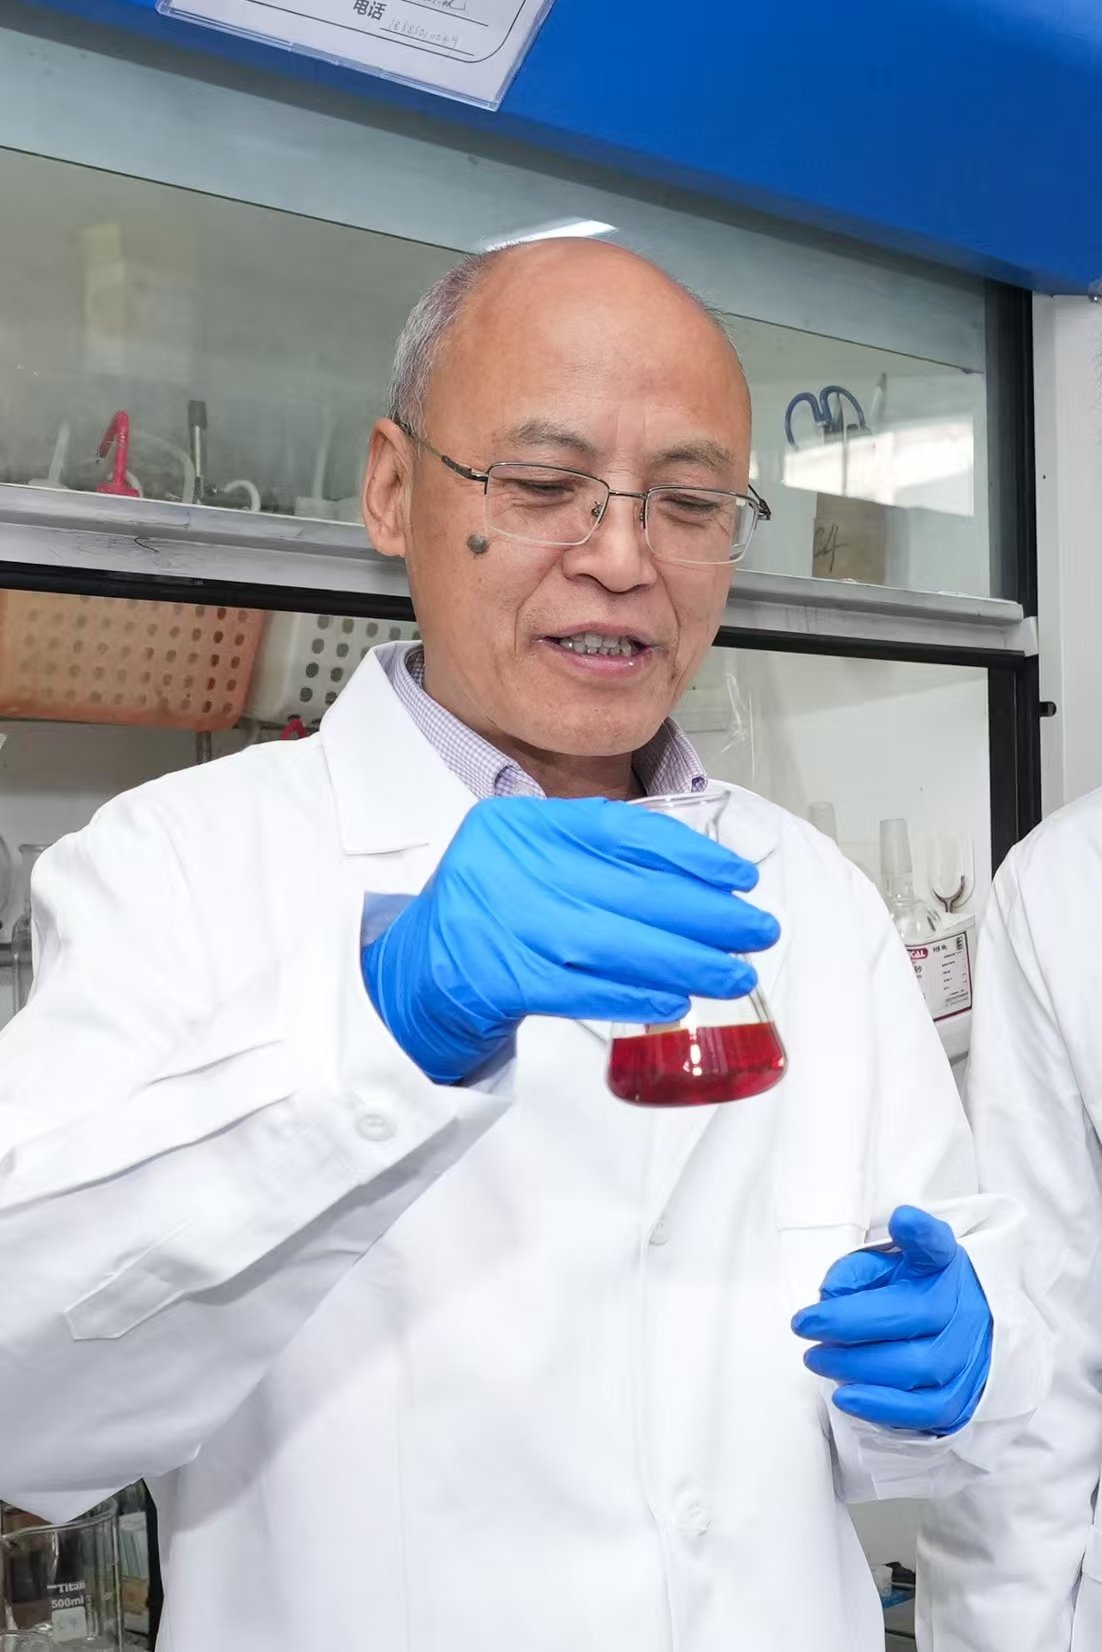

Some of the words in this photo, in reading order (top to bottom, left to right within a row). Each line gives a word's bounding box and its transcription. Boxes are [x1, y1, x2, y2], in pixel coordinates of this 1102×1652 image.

[353, 0, 387, 20] 电话
[47, 1580, 86, 1594] Titan
[51, 1595, 84, 1608] 500ml
